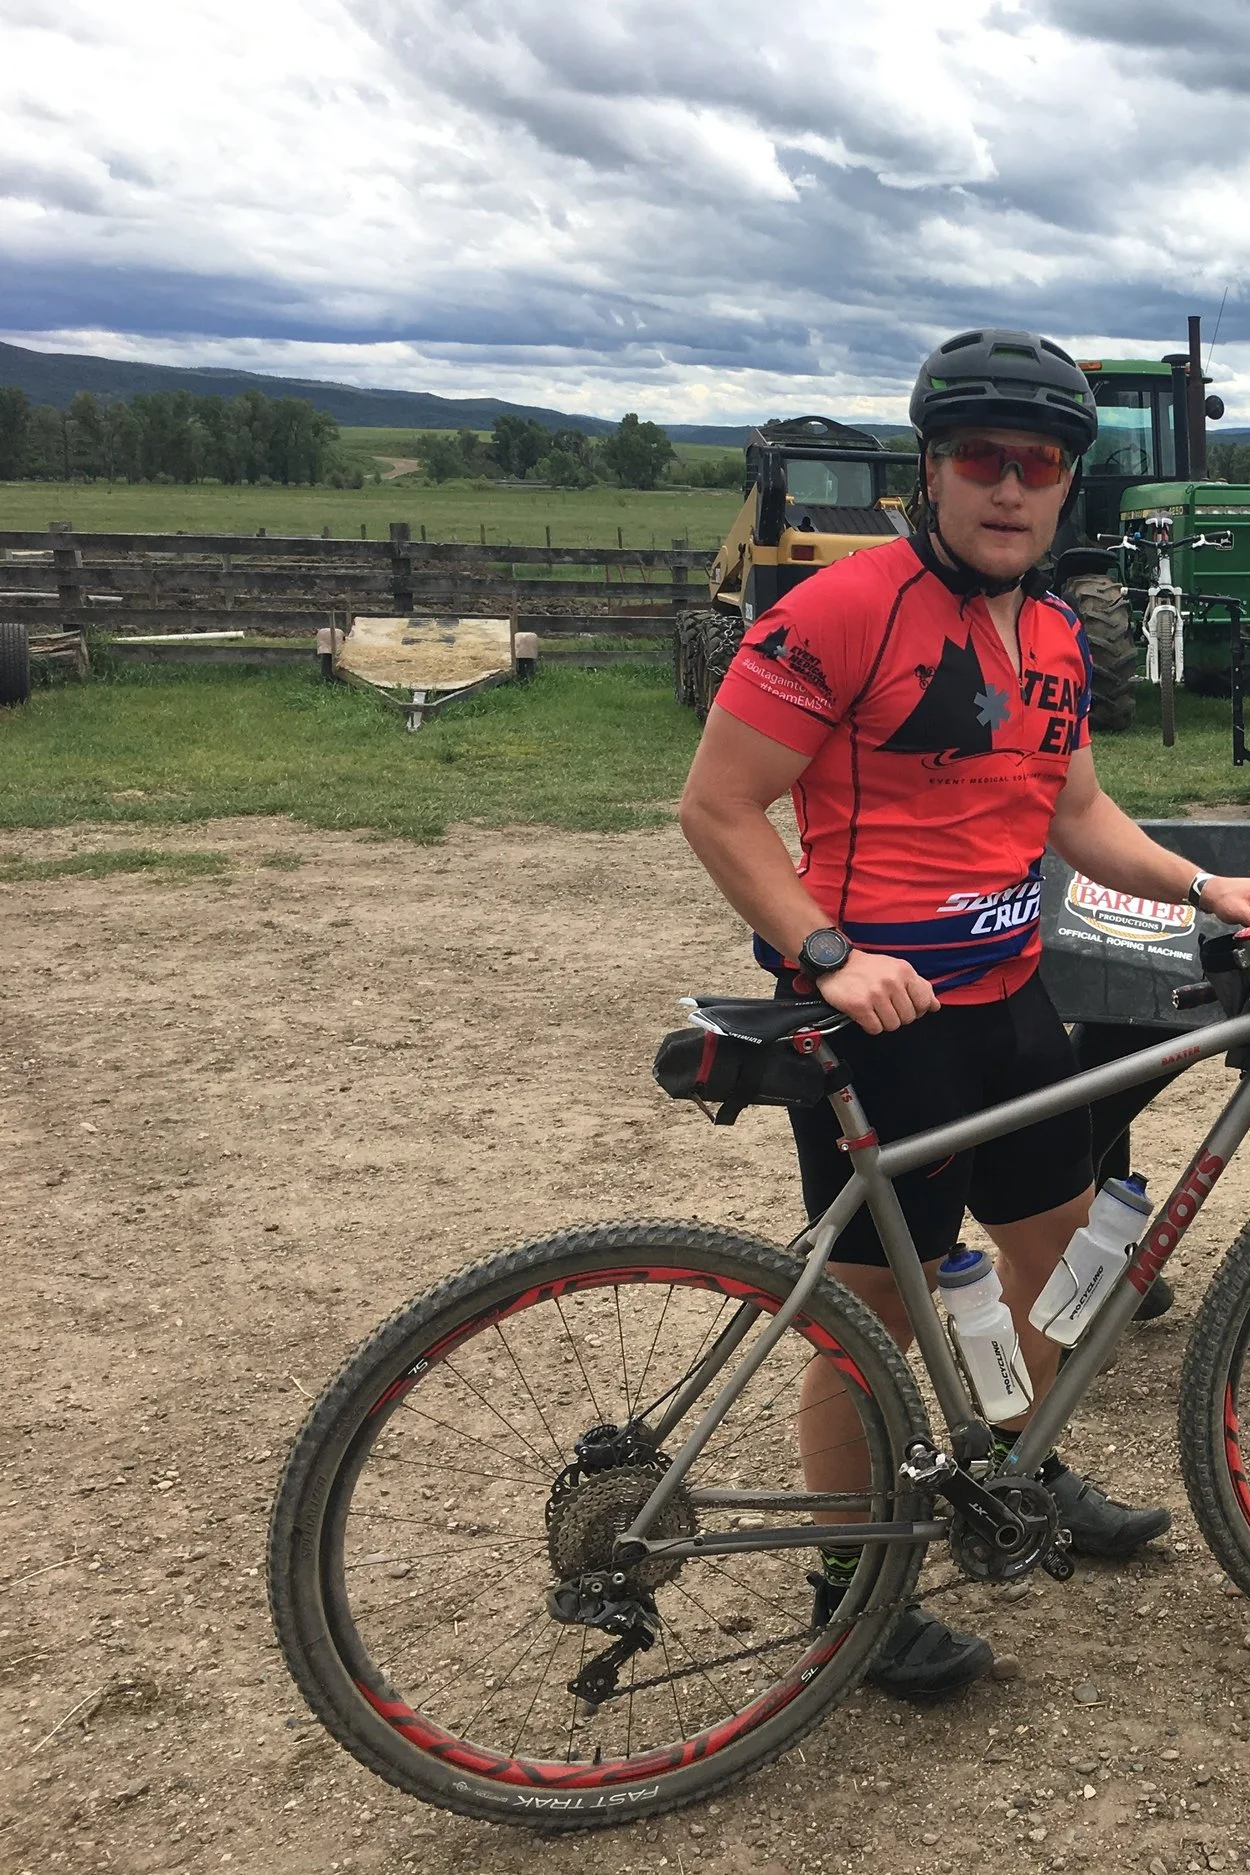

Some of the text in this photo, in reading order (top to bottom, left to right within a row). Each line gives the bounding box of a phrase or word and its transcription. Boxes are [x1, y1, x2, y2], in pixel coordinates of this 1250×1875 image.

[1078, 886, 1186, 922] BARTER
[1098, 912, 1159, 930] PRODUCTIONS
[1058, 927, 1194, 961] OFFICIAL ROPING MACHINE
[1126, 1148, 1225, 1296] MOOTS
[512, 1785, 660, 1810] FAST TRAK
